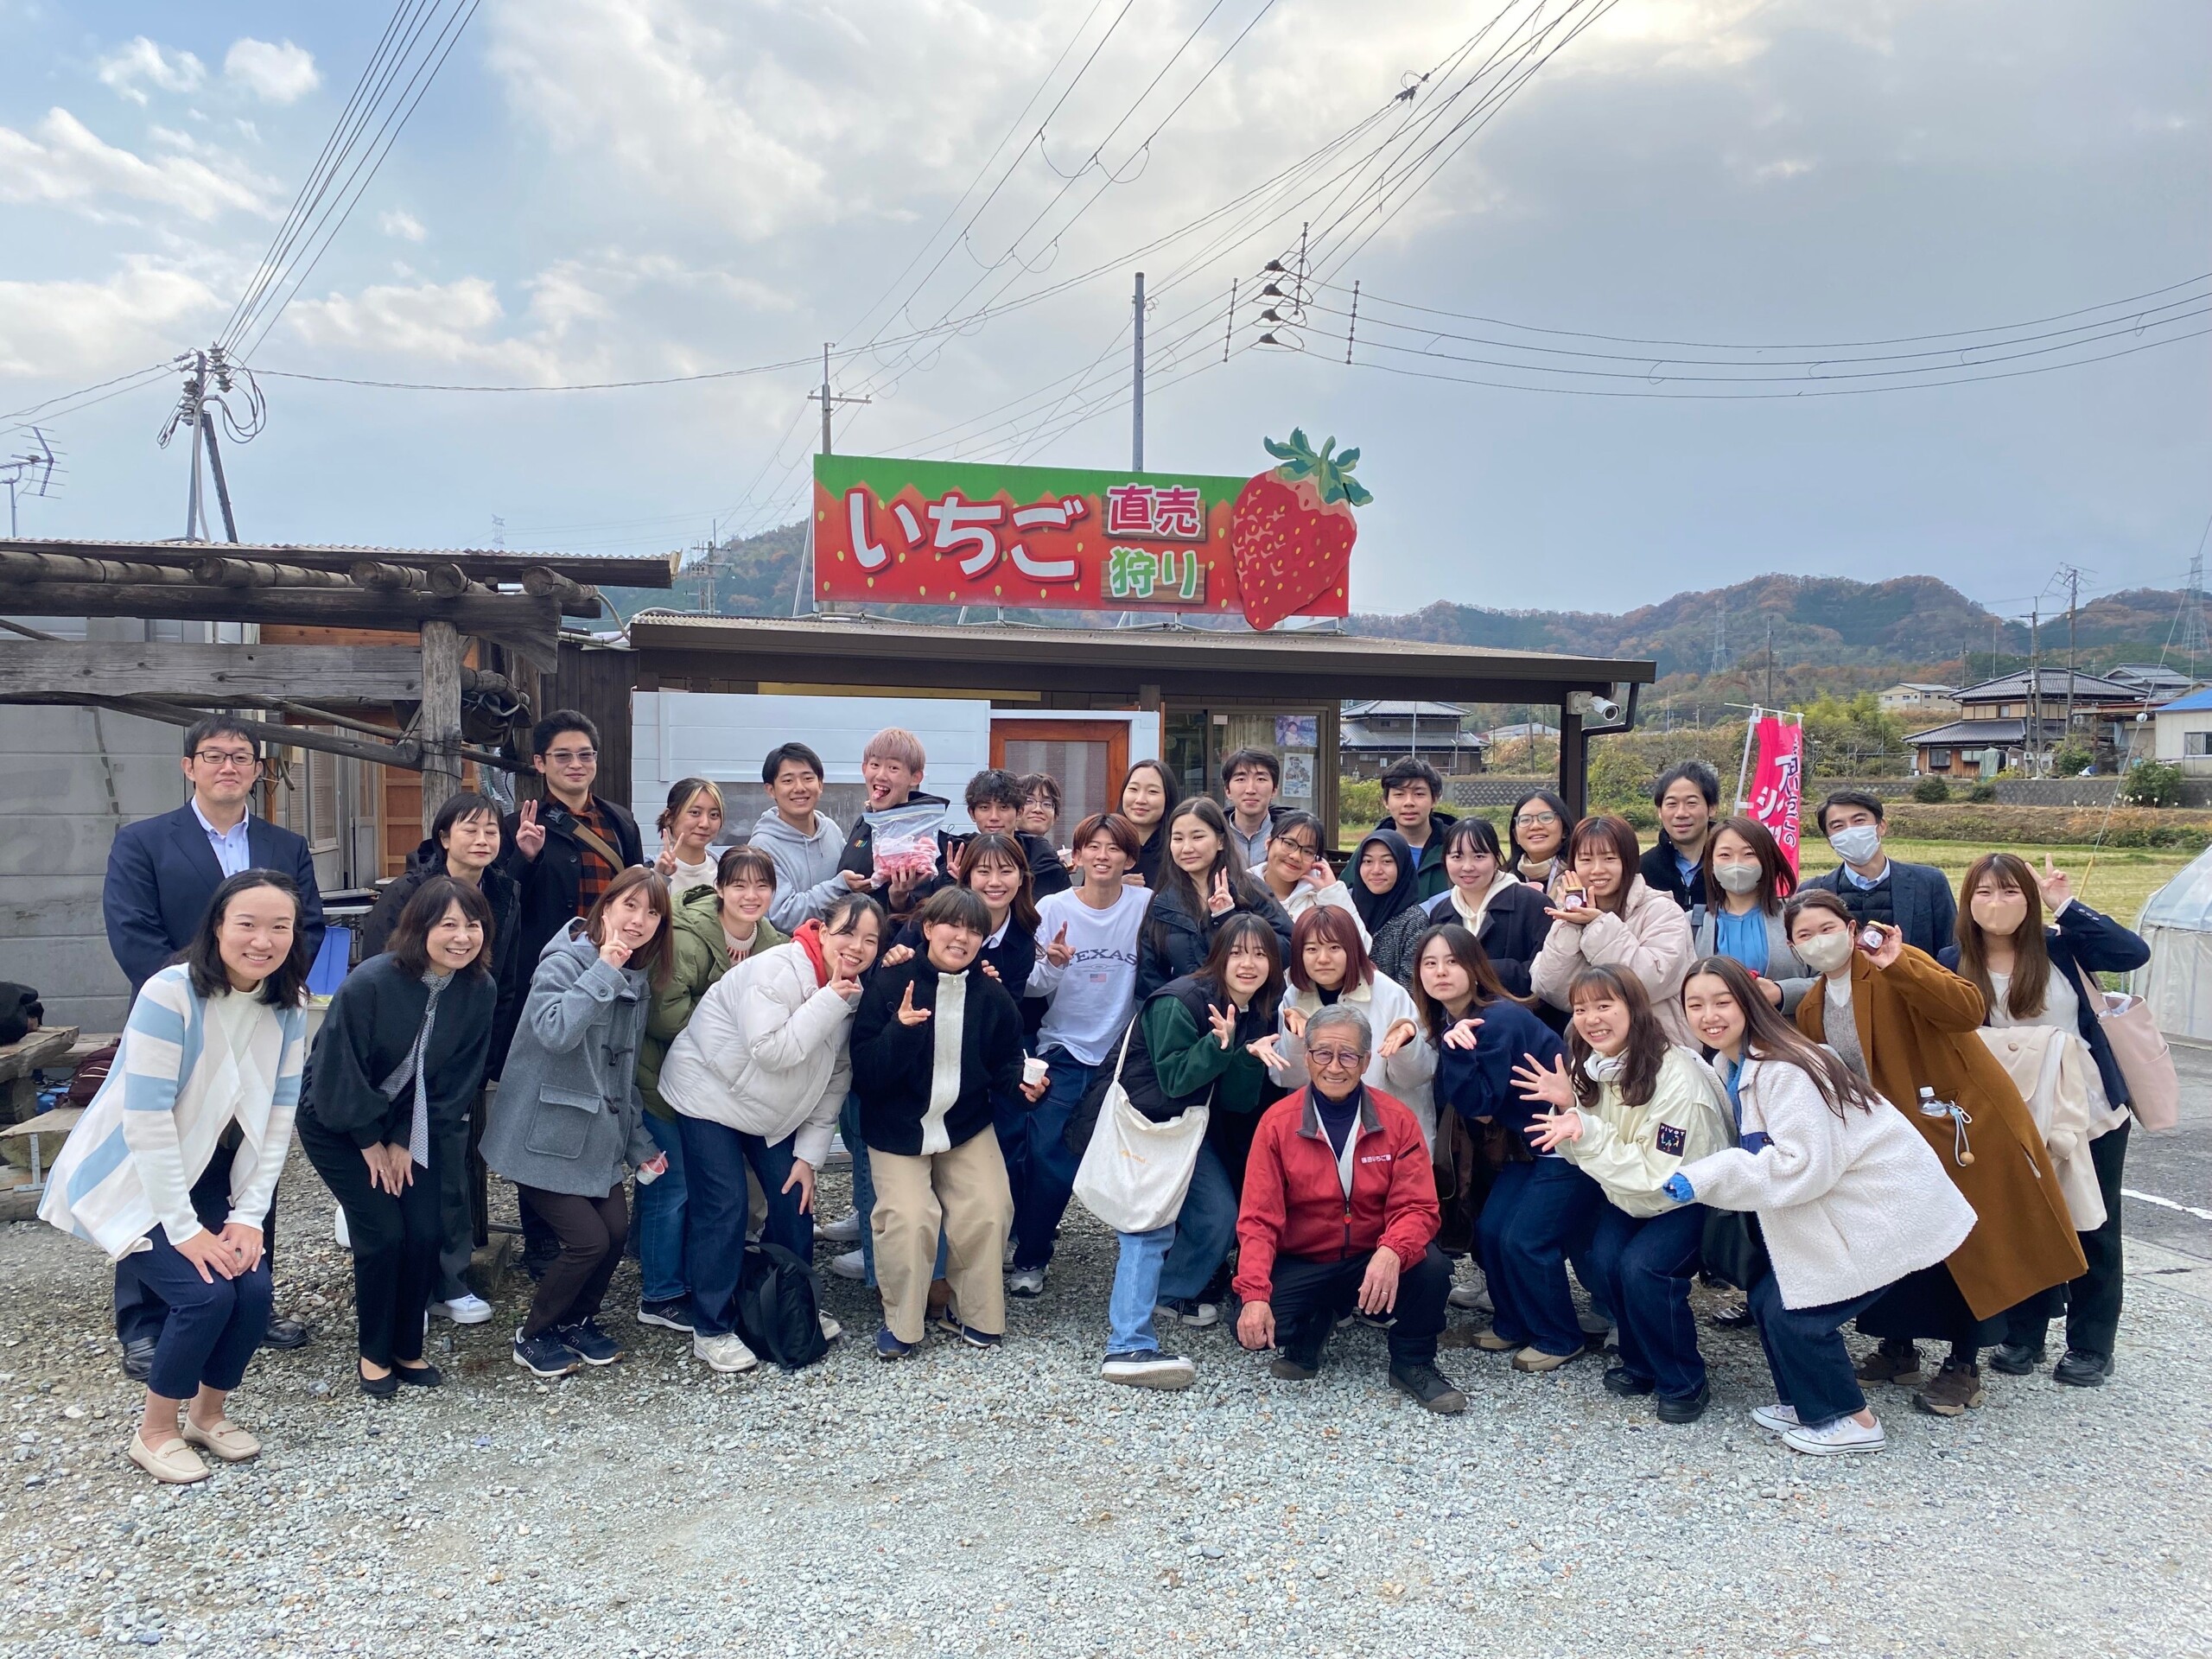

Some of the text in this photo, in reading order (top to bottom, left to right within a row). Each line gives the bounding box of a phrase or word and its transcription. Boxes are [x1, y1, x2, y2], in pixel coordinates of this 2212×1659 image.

[849, 490, 1086, 578] いちご
[1107, 483, 1200, 537] 直売
[1109, 546, 1198, 599] 狩り
[1070, 948, 1138, 966] EXAS
[1660, 1125, 1685, 1136] PIVOT
